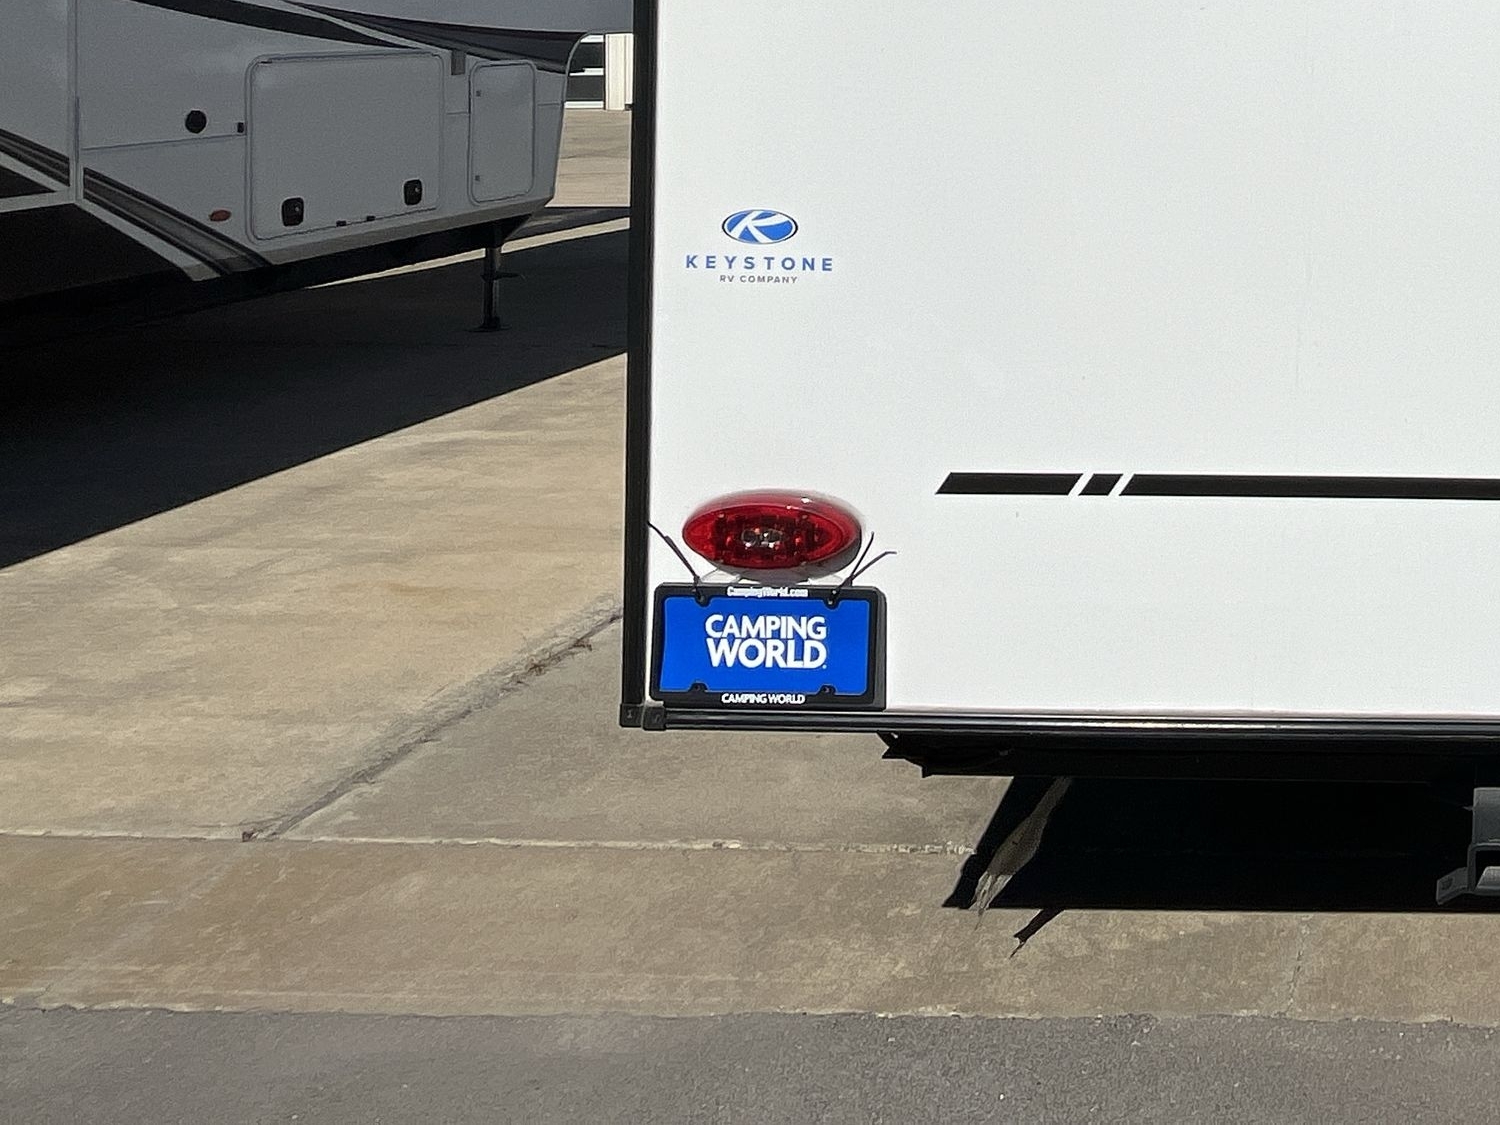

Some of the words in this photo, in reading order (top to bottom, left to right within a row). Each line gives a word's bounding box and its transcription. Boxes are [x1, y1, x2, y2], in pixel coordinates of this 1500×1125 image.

[685, 254, 833, 272] KEYSTONE
[719, 274, 735, 284] RV
[739, 275, 798, 285] COMPANY
[705, 614, 827, 640] CAMPING
[706, 638, 827, 669] WORLD
[721, 693, 767, 704] CAMPING
[768, 693, 806, 704] WORLD
